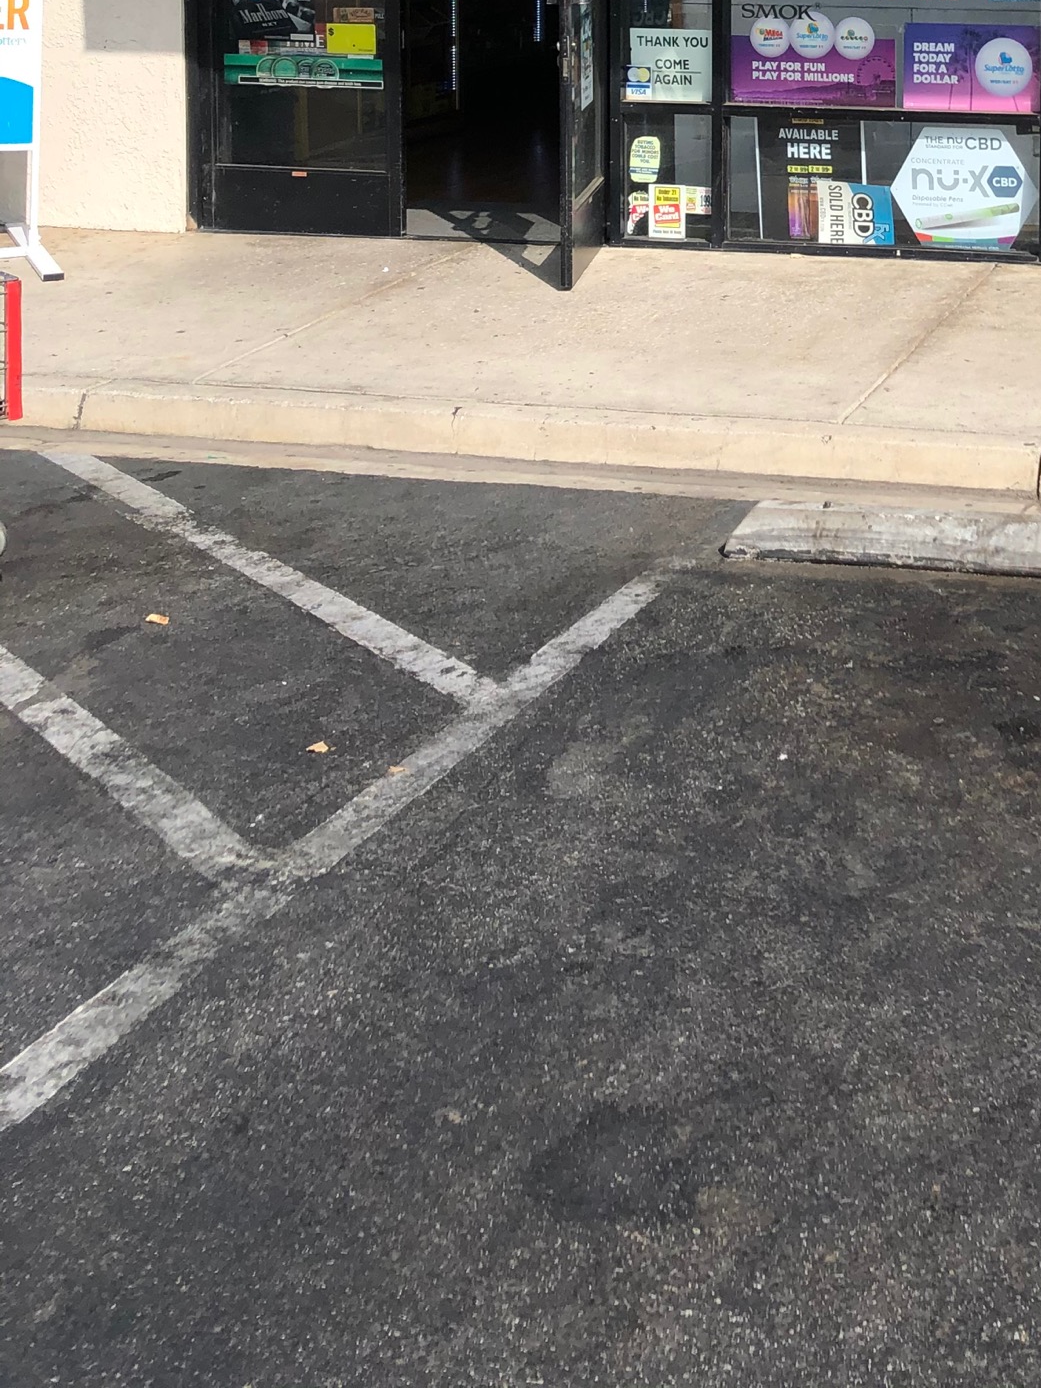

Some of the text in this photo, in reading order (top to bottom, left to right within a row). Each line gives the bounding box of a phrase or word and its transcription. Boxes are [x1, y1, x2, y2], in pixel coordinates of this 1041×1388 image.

[239, 4, 289, 25] Marlboro
[741, 4, 816, 21] SMOK
[636, 35, 709, 48] THANK YOU
[913, 42, 955, 52] DREAM
[913, 53, 952, 63] TODAY
[654, 59, 690, 70] COME
[752, 61, 826, 72] PLAY FOR FUN
[913, 64, 948, 73] FOR A
[654, 74, 693, 86] AGAIN
[752, 71, 855, 82] PLAY FOR MILLIONS
[913, 74, 959, 84] DOLLAR
[778, 128, 839, 140] AVAILABLE
[924, 135, 944, 144] THE
[964, 136, 1002, 150] CBD
[787, 142, 832, 160] HERE
[910, 157, 965, 165] CONCENTRATE
[992, 177, 1018, 187] CBD
[948, 195, 964, 203] Pens
[658, 205, 676, 213] We
[828, 184, 845, 244] SOLD HERE
[655, 212, 680, 221] Card
[851, 193, 874, 238] CBD
